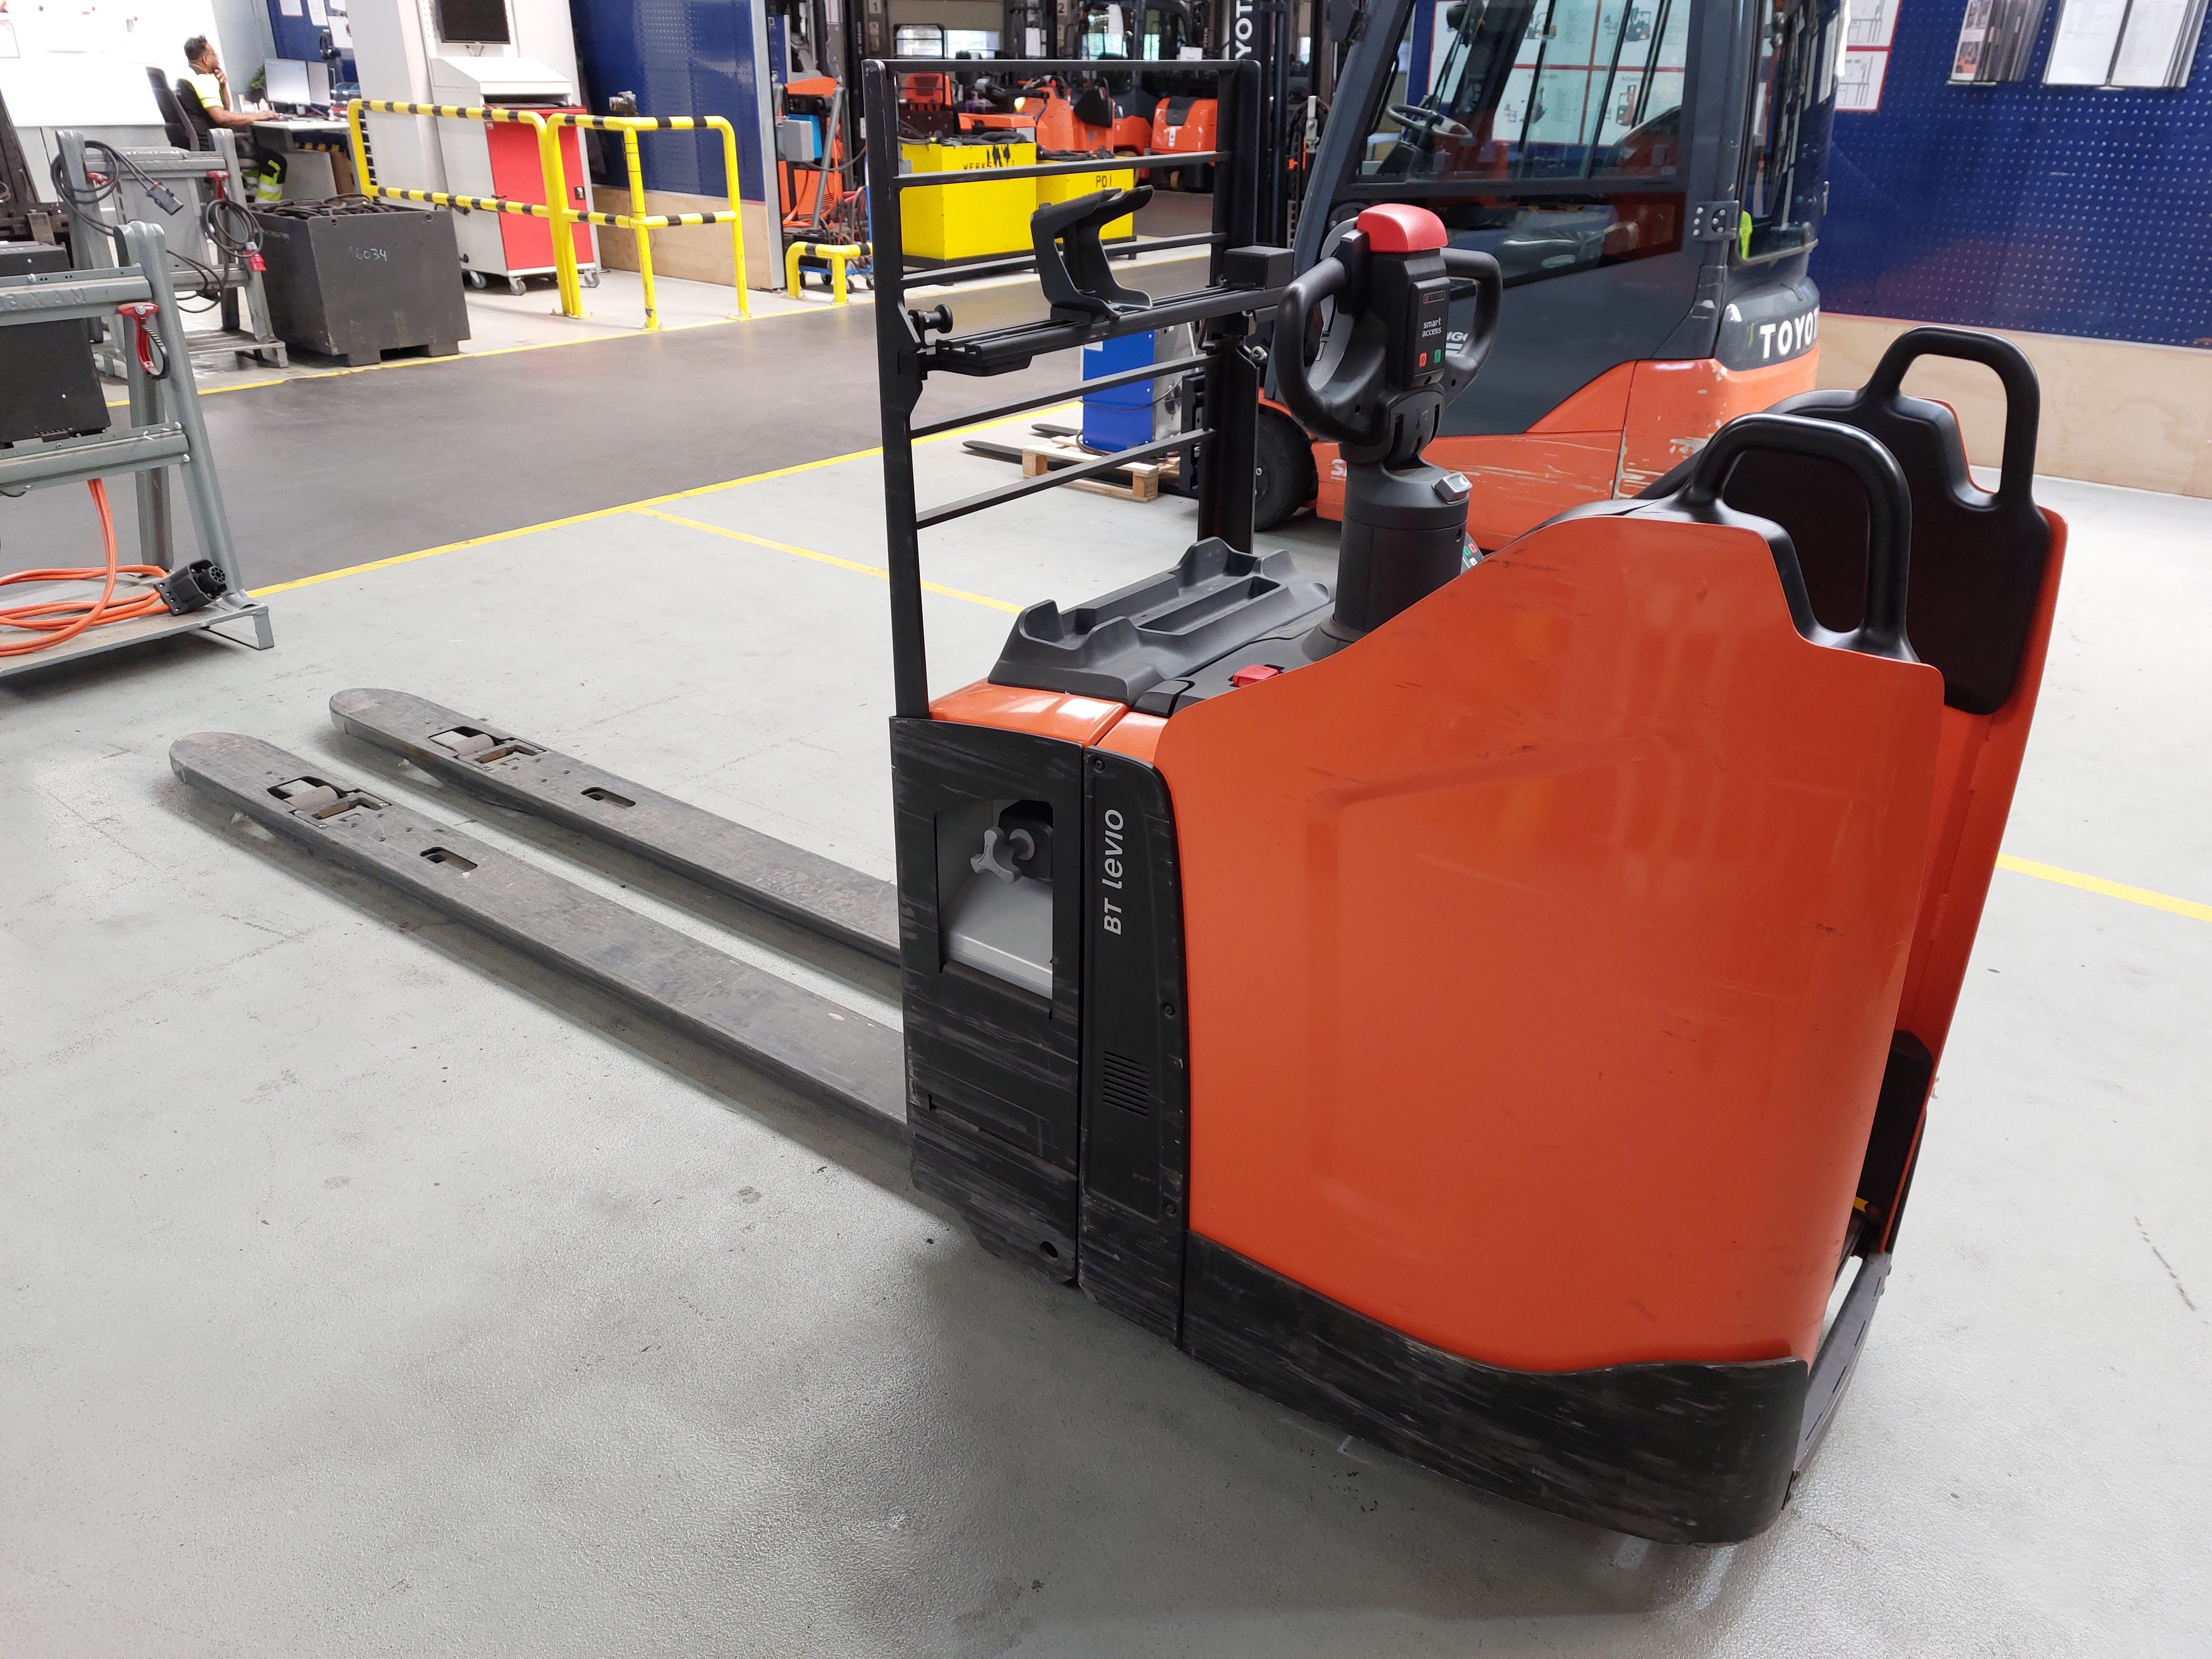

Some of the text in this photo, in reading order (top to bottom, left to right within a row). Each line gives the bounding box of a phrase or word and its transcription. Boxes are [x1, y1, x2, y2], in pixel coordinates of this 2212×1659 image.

[1058, 2, 1065, 13] 2
[1235, 0, 1253, 60] YOT
[1423, 317, 1441, 329] smart
[1422, 327, 1442, 337] access
[1104, 897, 1122, 935] BT
